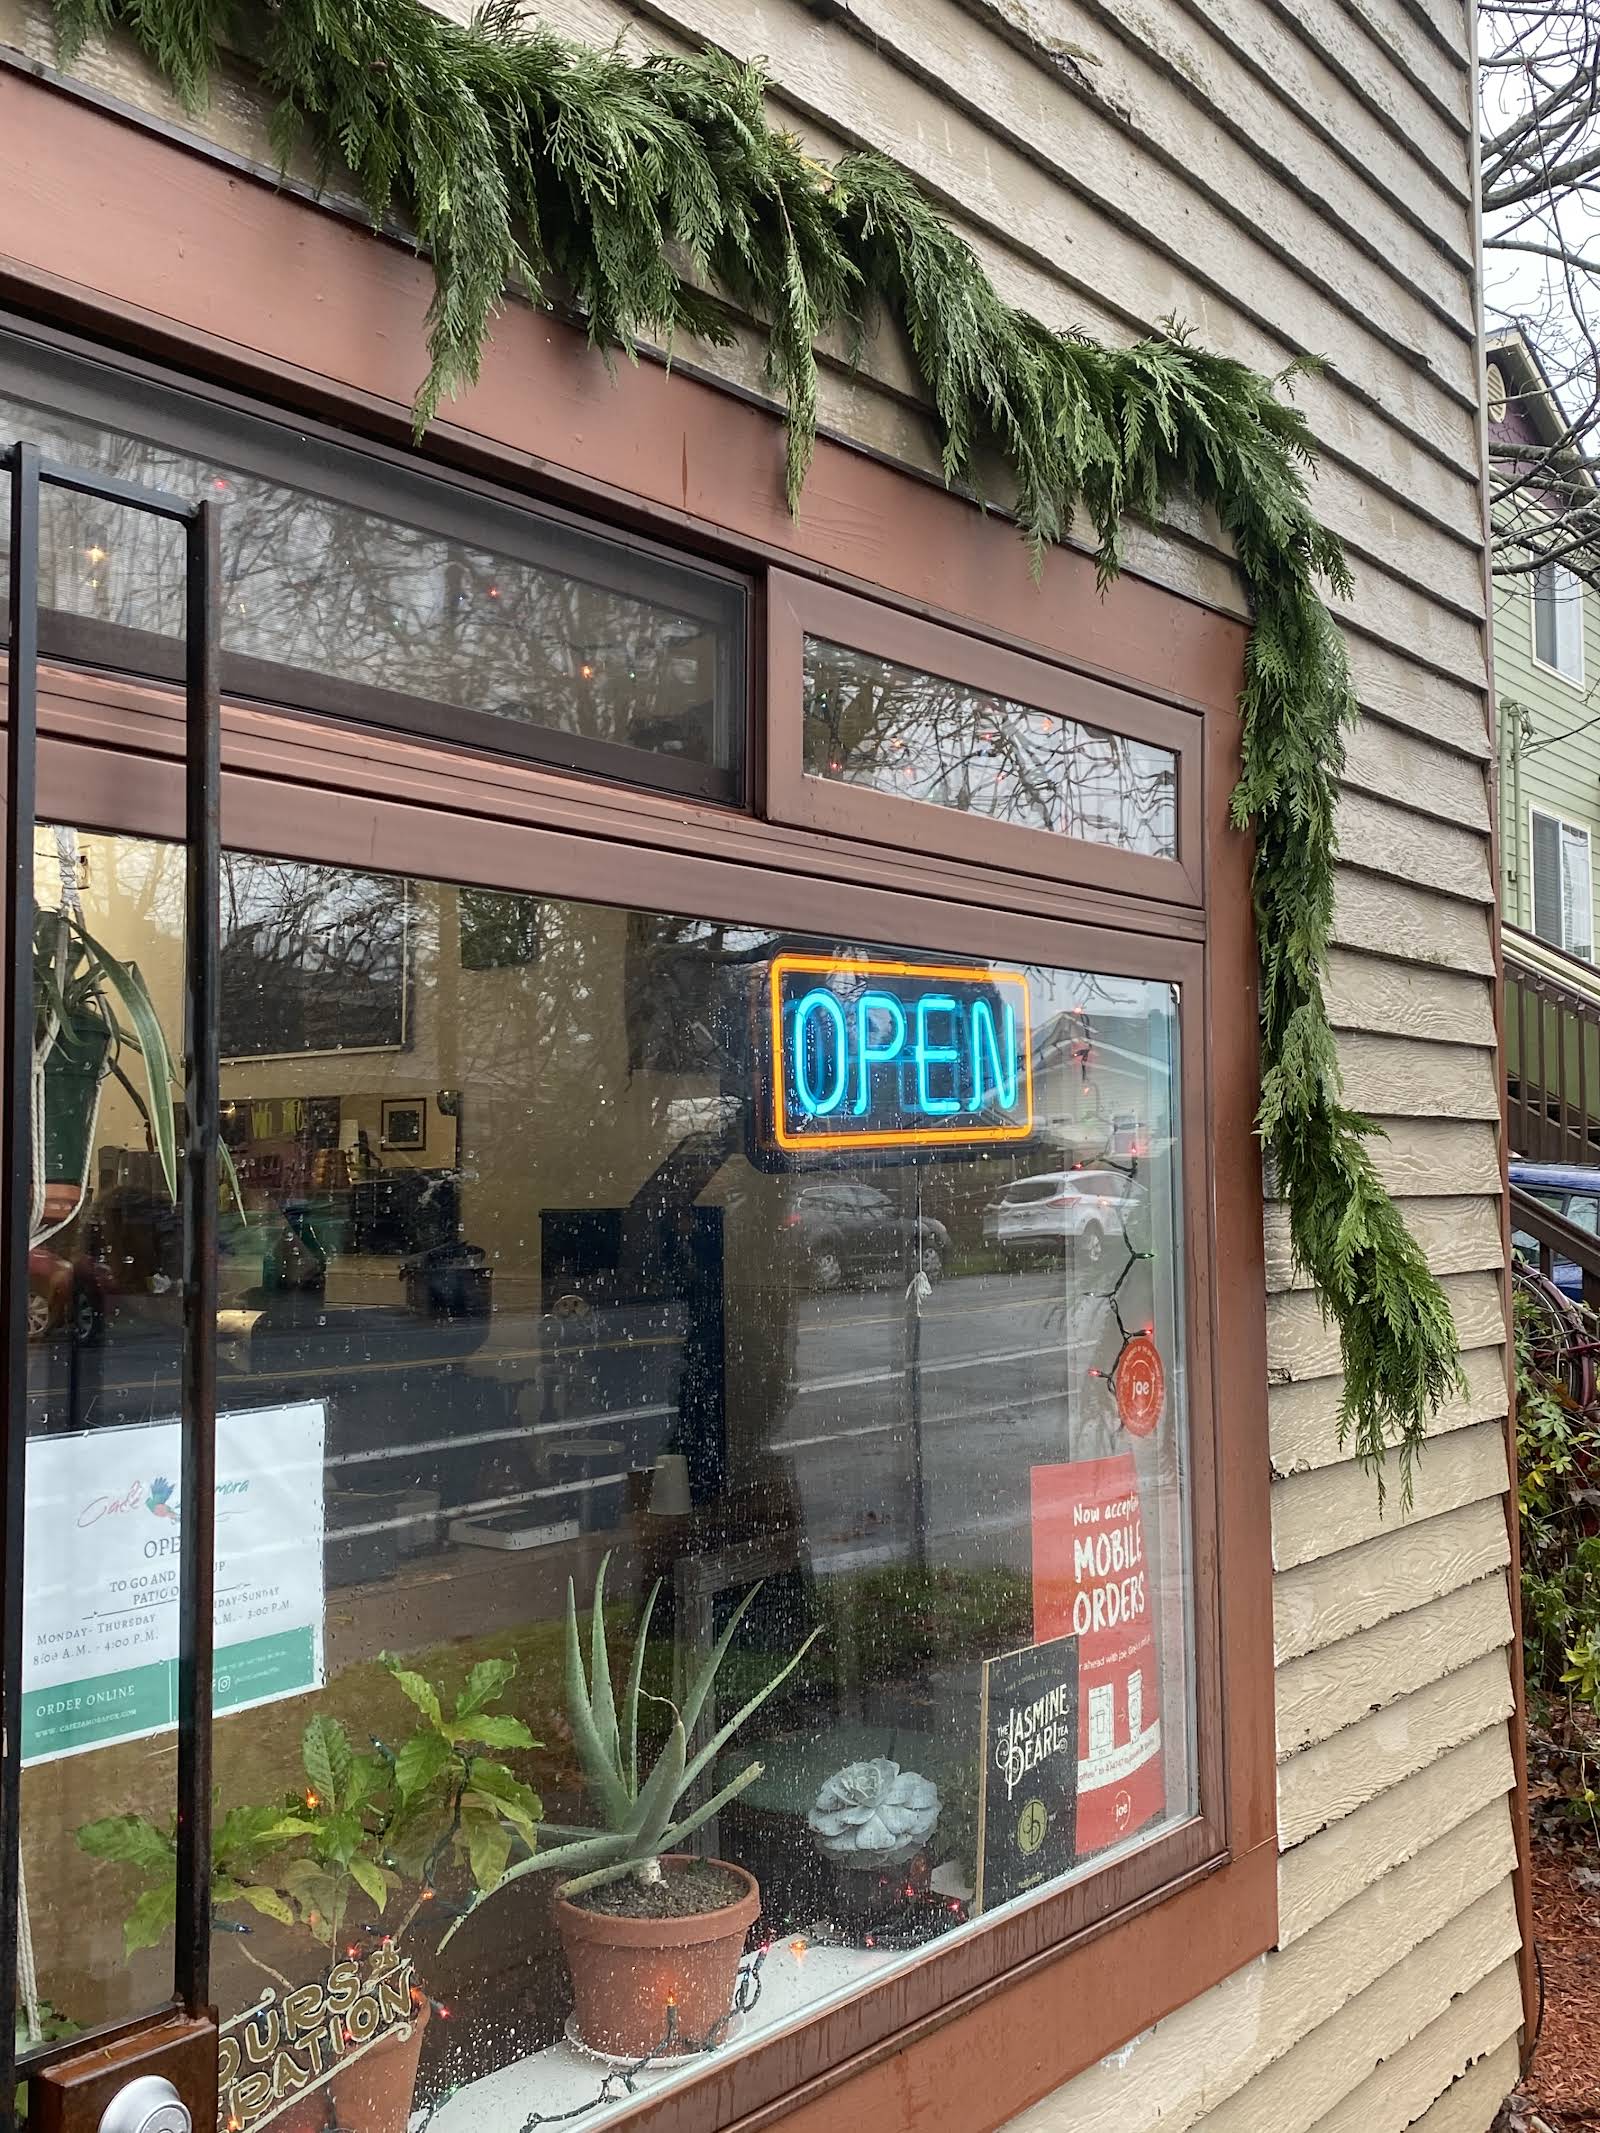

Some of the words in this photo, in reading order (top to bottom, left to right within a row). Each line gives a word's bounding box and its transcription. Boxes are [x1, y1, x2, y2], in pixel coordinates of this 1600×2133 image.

[794, 987, 1018, 1116] OPEN
[1132, 1375, 1150, 1401] joe
[1073, 1503, 1100, 1527] Now
[1104, 1491, 1140, 1521] accept
[144, 1536, 181, 1559] OPE
[1073, 1520, 1142, 1584] MOBILE
[109, 1580, 127, 1593] TO
[130, 1576, 148, 1589] GO
[151, 1570, 176, 1585] AND
[133, 1587, 169, 1605] PATIO
[1073, 1571, 1145, 1636] ORDERS
[105, 1638, 129, 1652] 4:00
[134, 1630, 159, 1644] P.M.
[36, 1697, 82, 1717] ORDER
[86, 1685, 135, 1706] ONLINE
[997, 1724, 1009, 1737] THE
[1001, 1684, 1070, 1756] JASMINE
[1005, 1721, 1061, 1796] PEARL
[1057, 1725, 1069, 1738] TEA
[1115, 1803, 1128, 1823] joe
[218, 1961, 361, 2093] OURS
[225, 1967, 413, 2130] RATION
